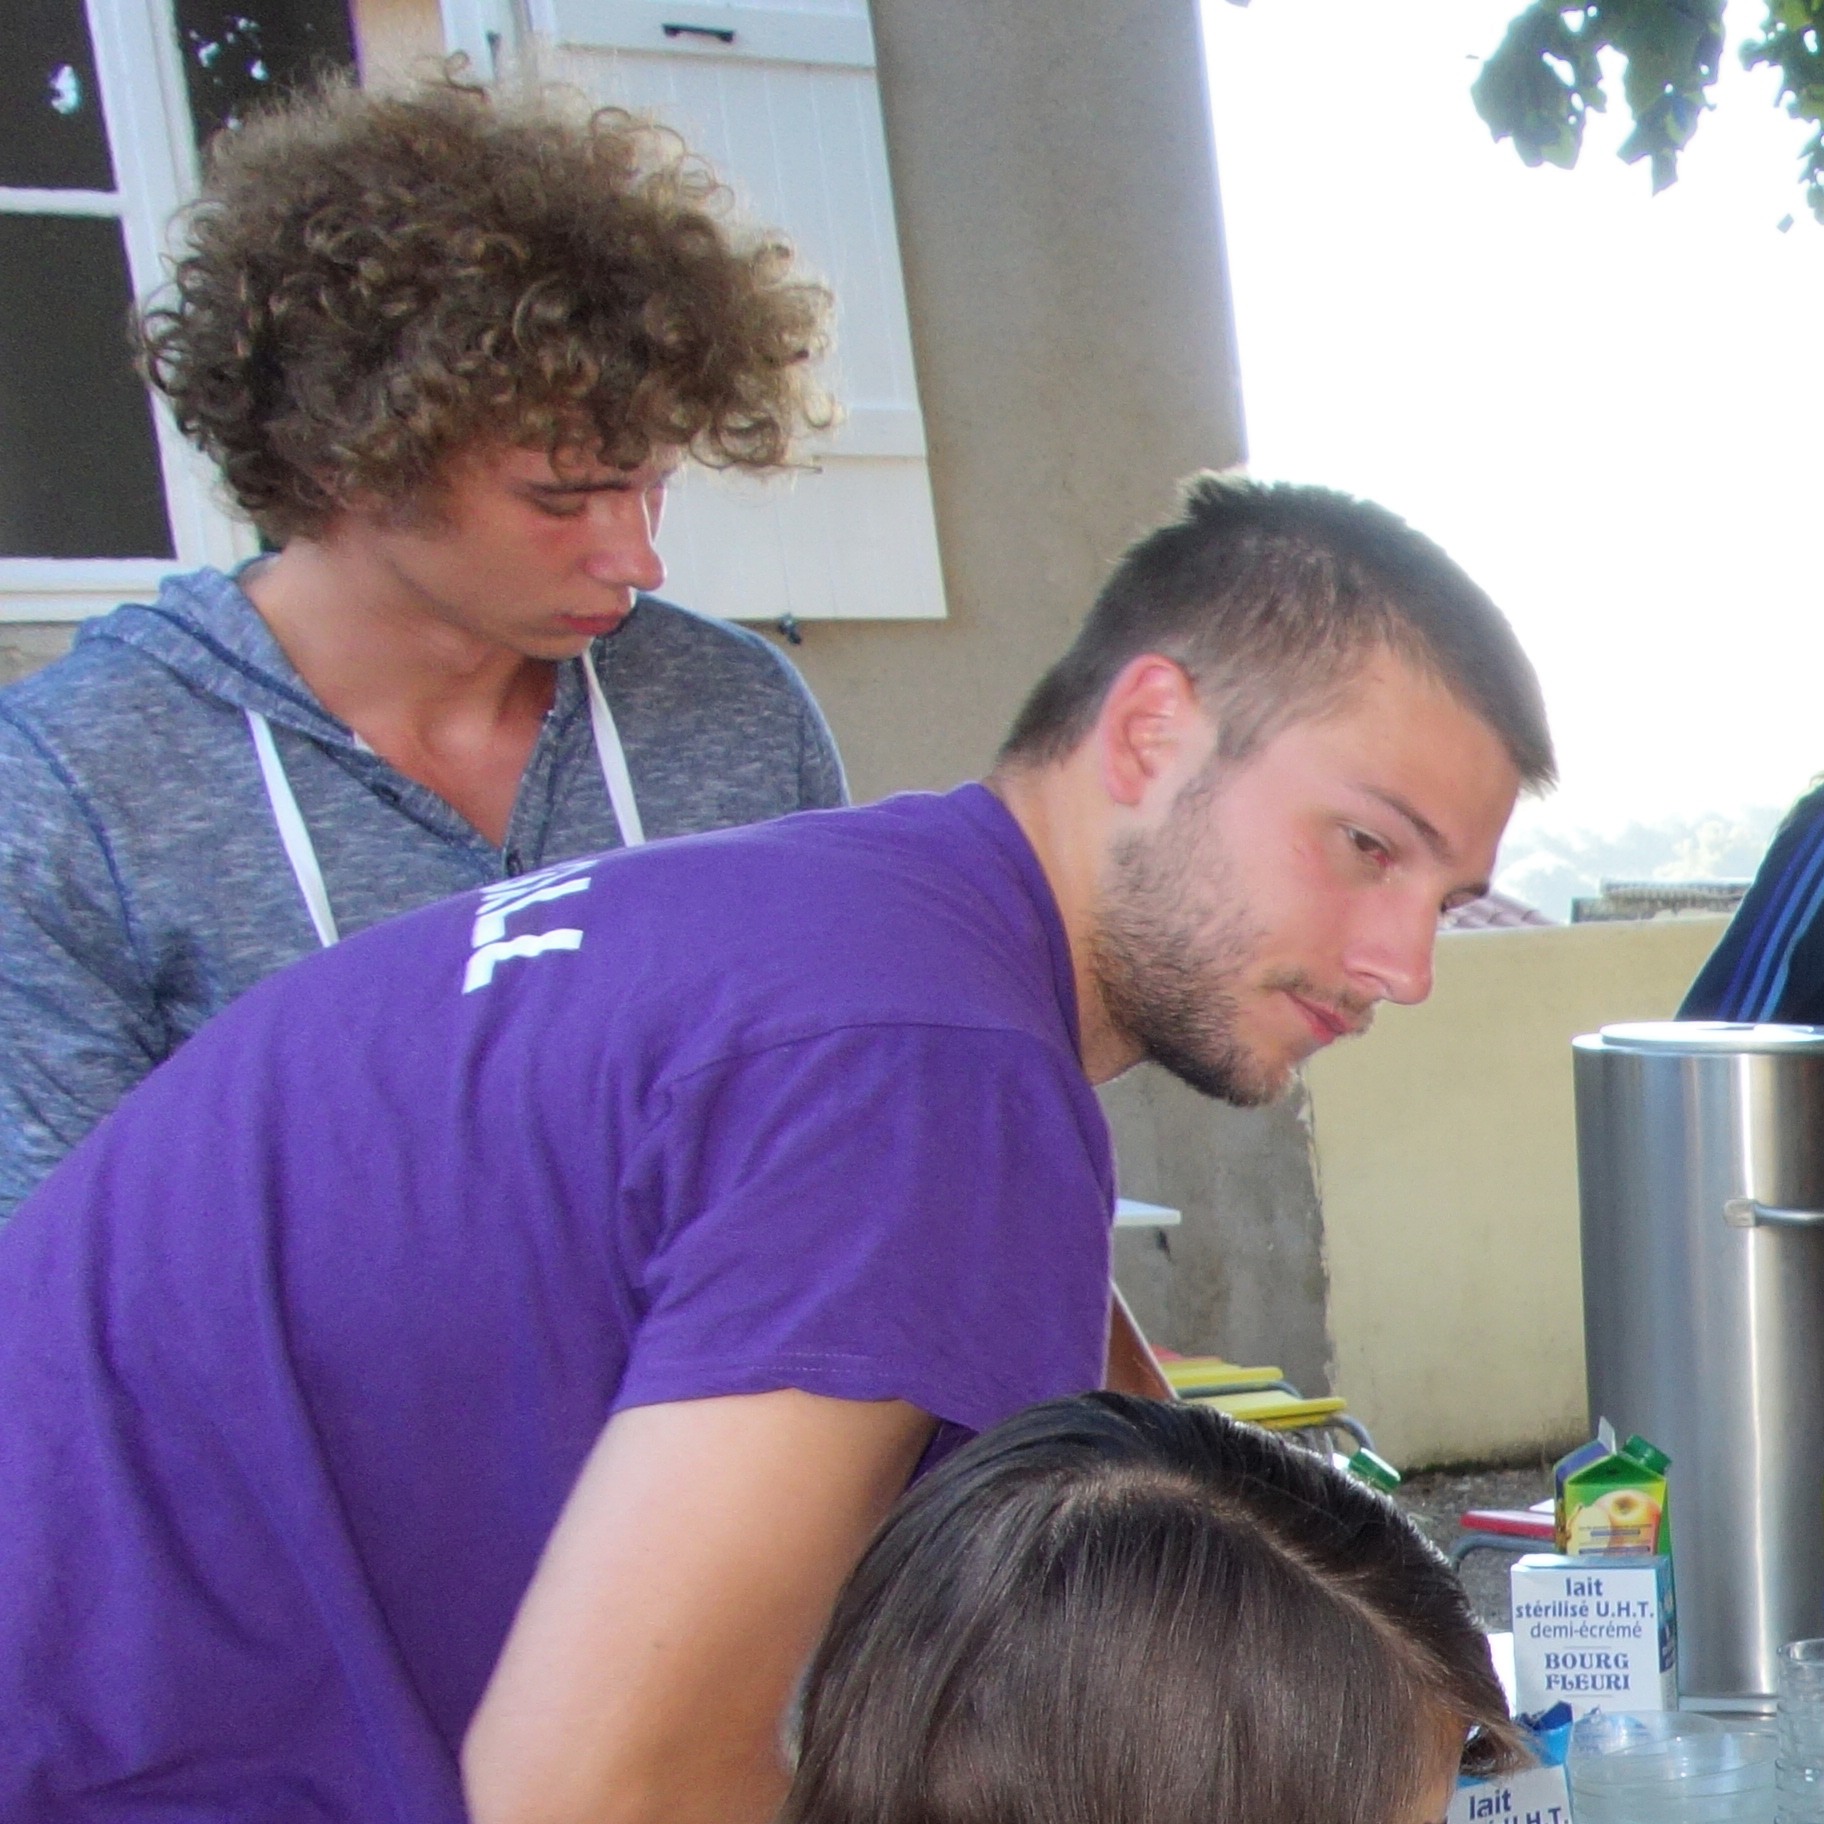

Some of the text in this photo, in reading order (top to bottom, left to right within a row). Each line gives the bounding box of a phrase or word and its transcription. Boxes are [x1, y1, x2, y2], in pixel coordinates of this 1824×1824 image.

[1566, 1577, 1603, 1597] lait
[1515, 1600, 1655, 1619] stérilisé U.H.T.
[1530, 1620, 1642, 1639] demi-écrémé
[1545, 1652, 1630, 1670] BOURG
[1546, 1673, 1631, 1692] FLEURI
[1469, 1791, 1512, 1820] lait
